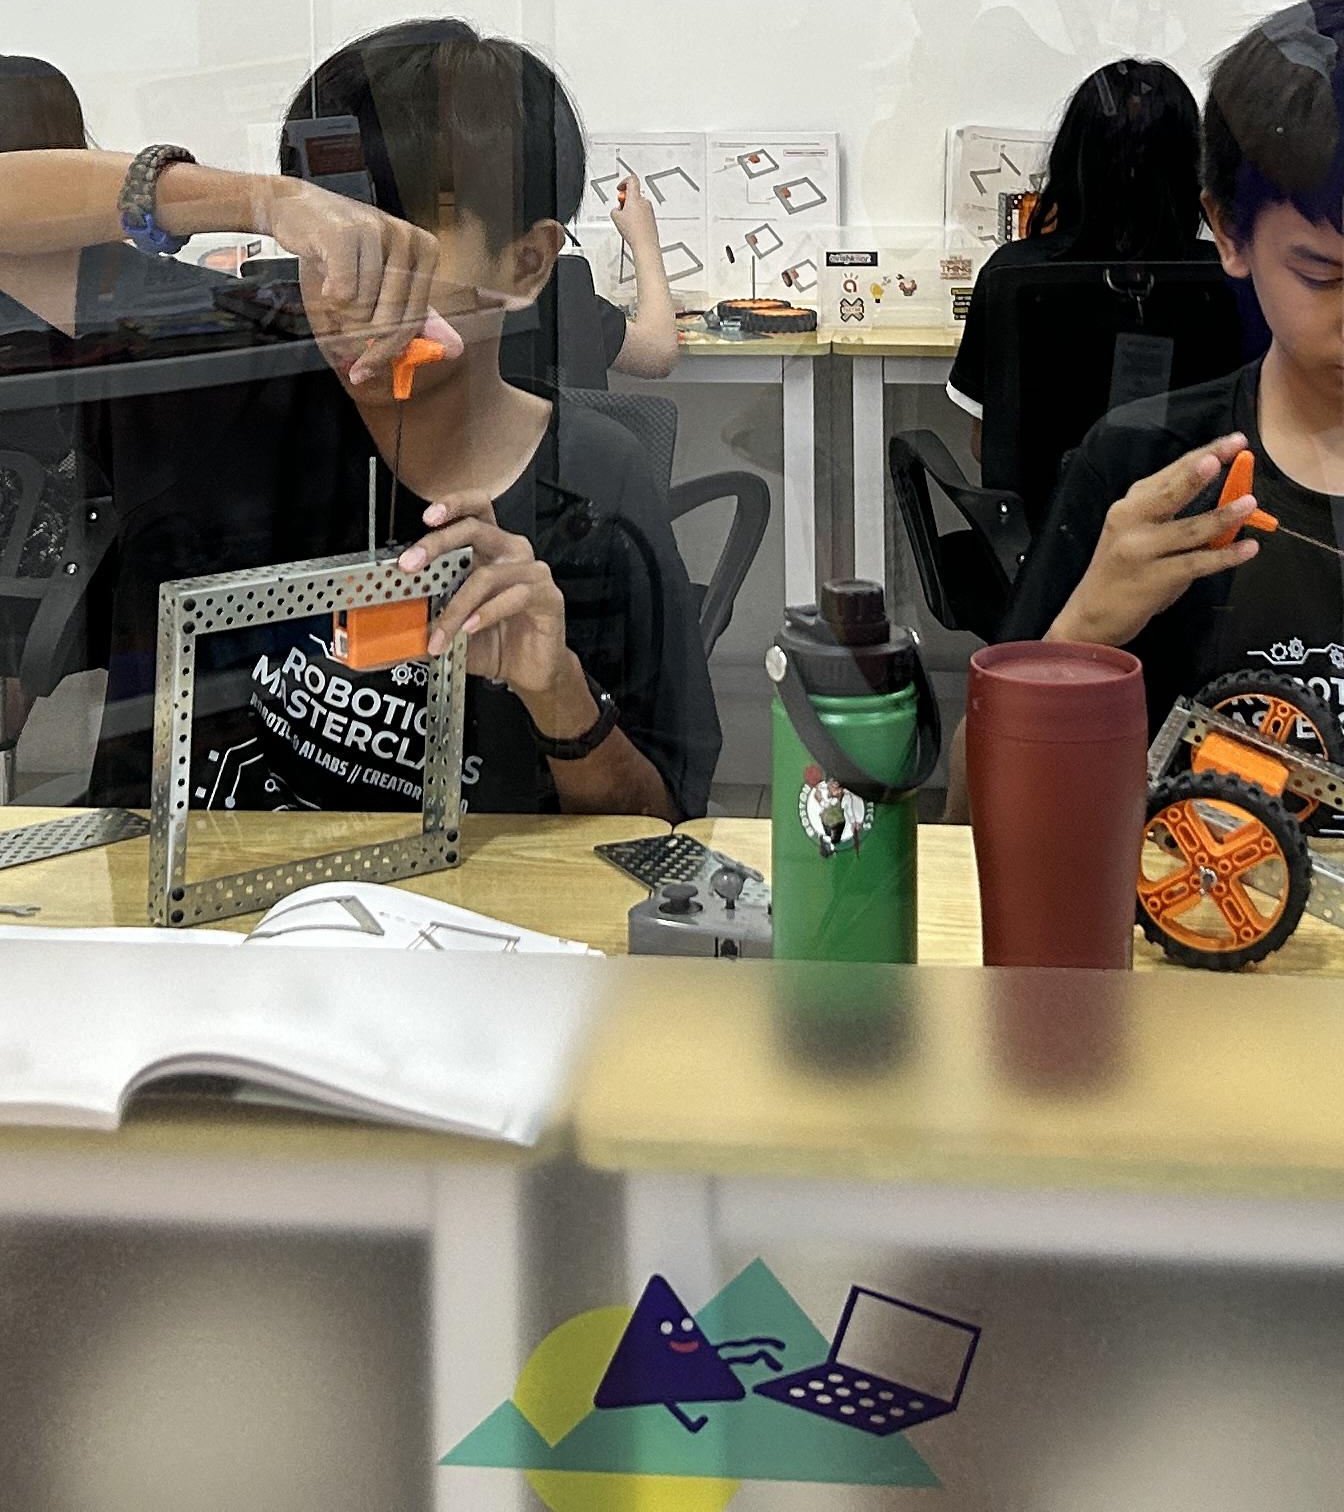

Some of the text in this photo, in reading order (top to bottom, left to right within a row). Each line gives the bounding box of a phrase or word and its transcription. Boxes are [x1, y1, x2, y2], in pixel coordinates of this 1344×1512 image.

[252, 654, 484, 785] MASTERCLS
[282, 646, 428, 736] ROBOTIC
[299, 740, 316, 759] AI
[315, 748, 349, 777] LABS
[362, 767, 425, 800] CREATOR
